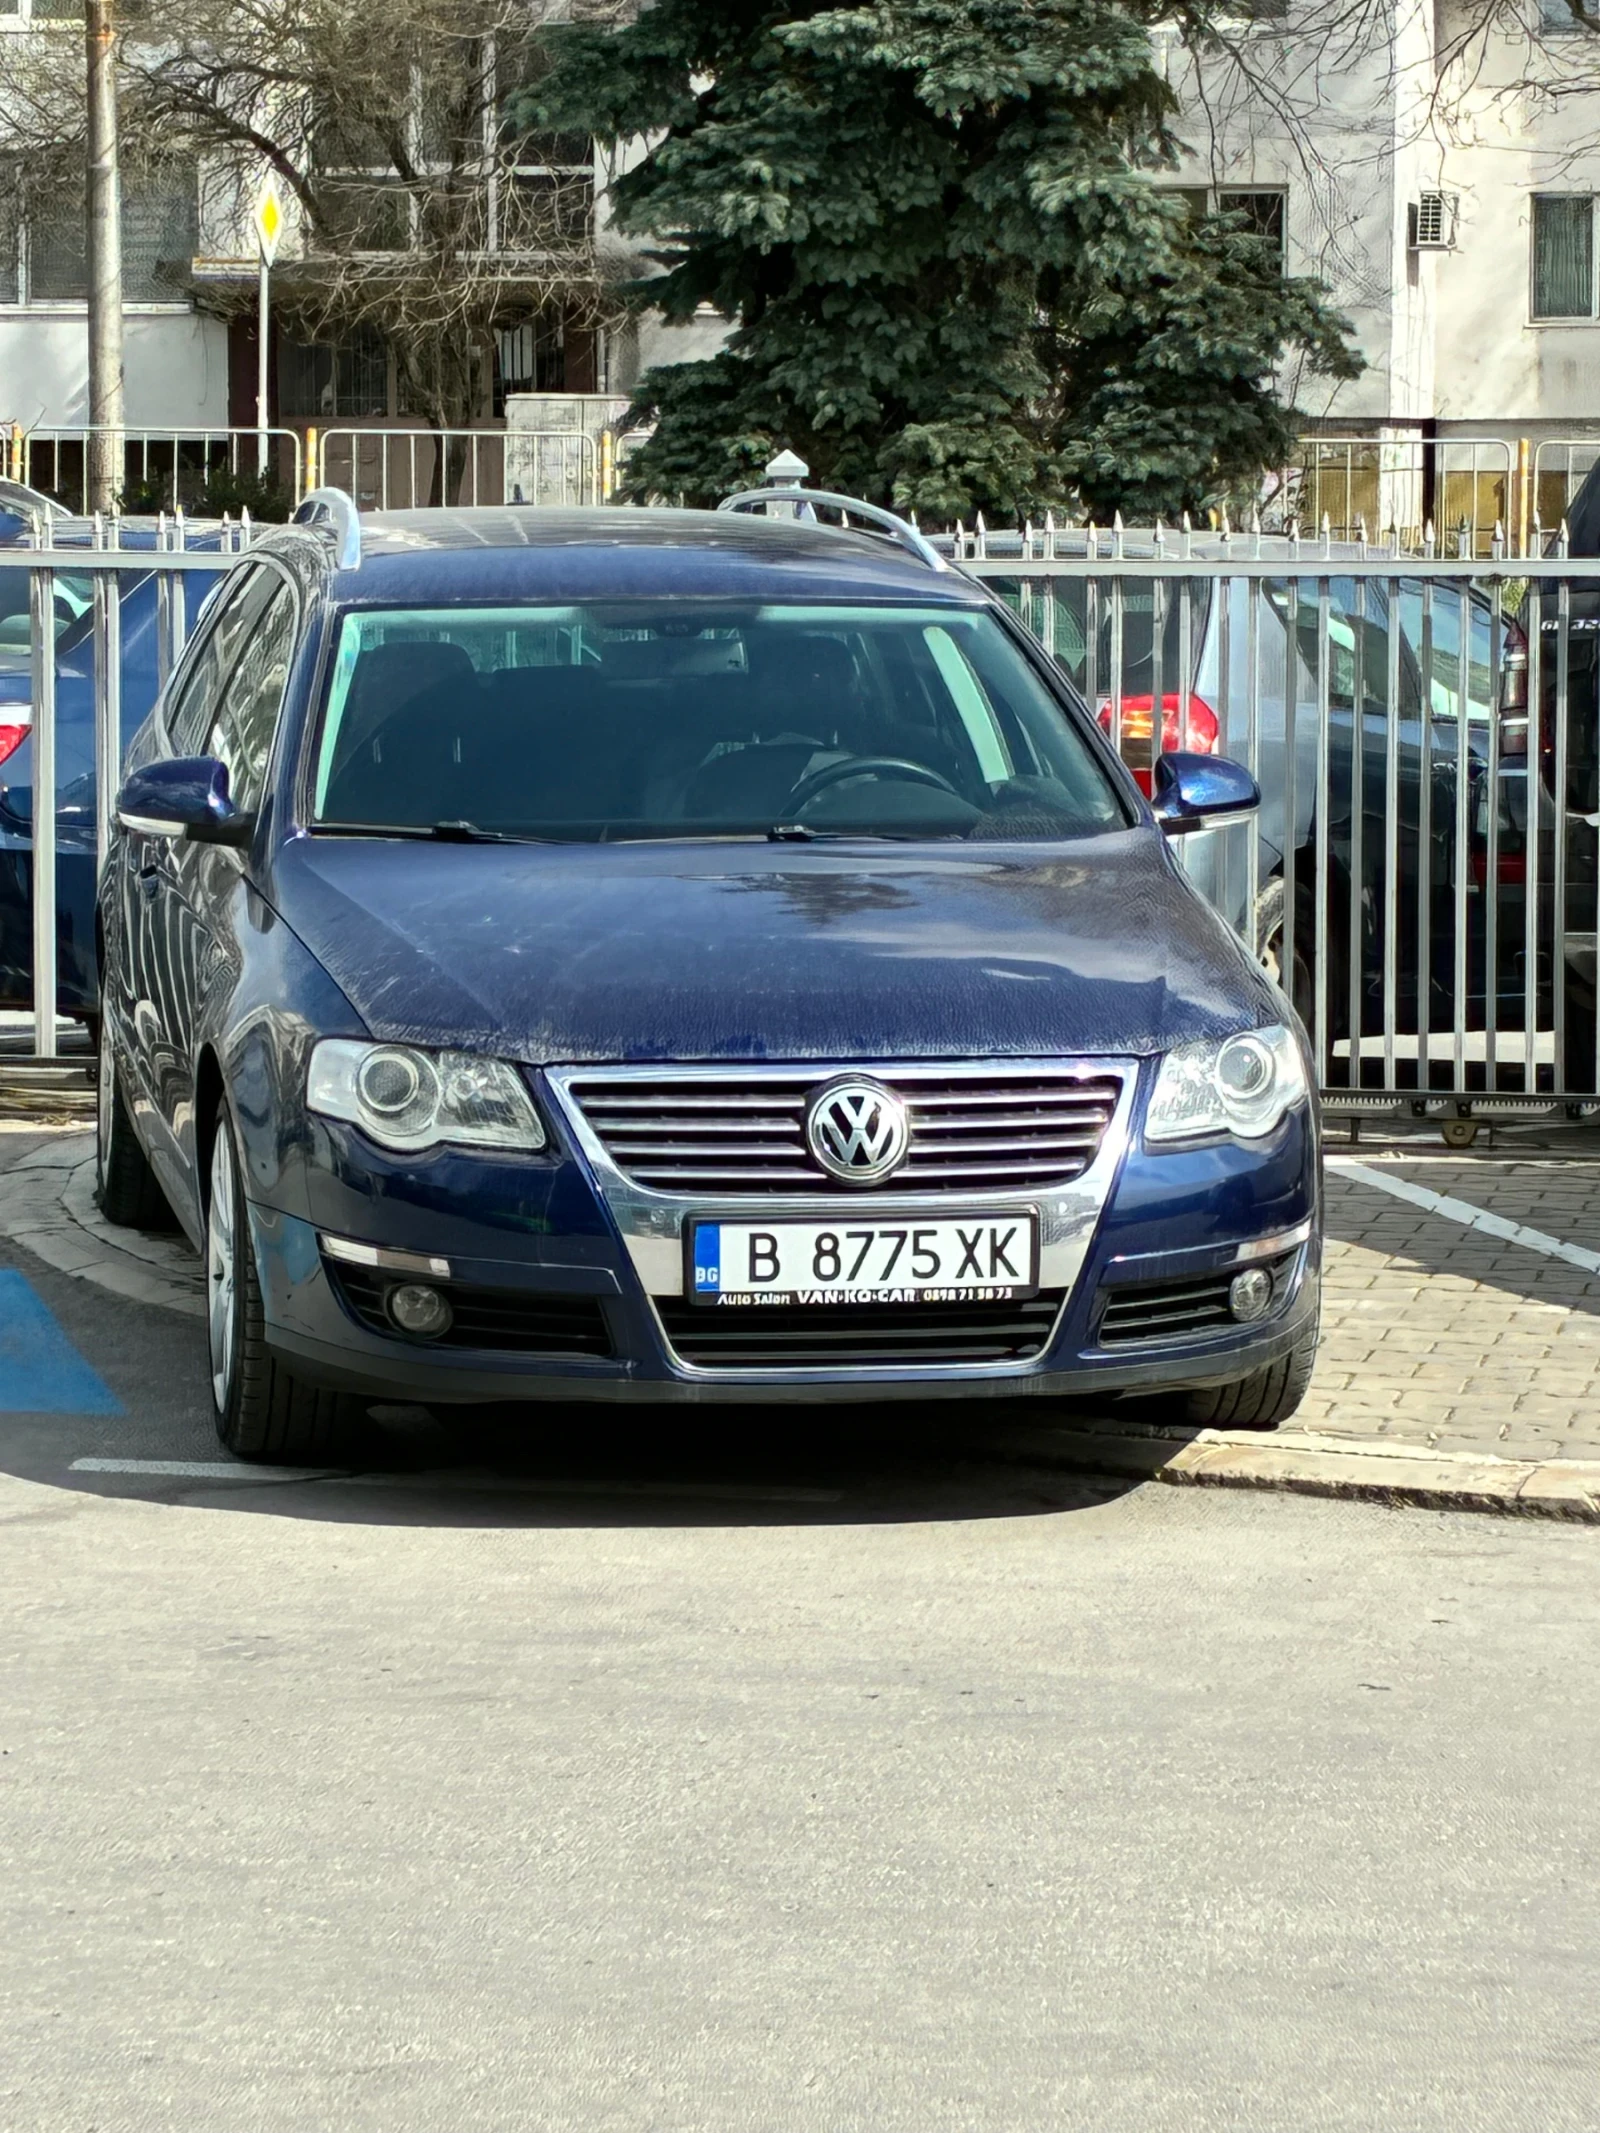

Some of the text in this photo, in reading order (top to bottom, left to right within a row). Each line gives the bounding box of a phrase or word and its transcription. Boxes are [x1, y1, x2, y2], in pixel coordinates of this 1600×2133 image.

[810, 1085, 905, 1178] VW
[748, 1227, 1020, 1283] B 8775 XK
[695, 1266, 718, 1283] BG
[717, 1292, 752, 1306] Auto
